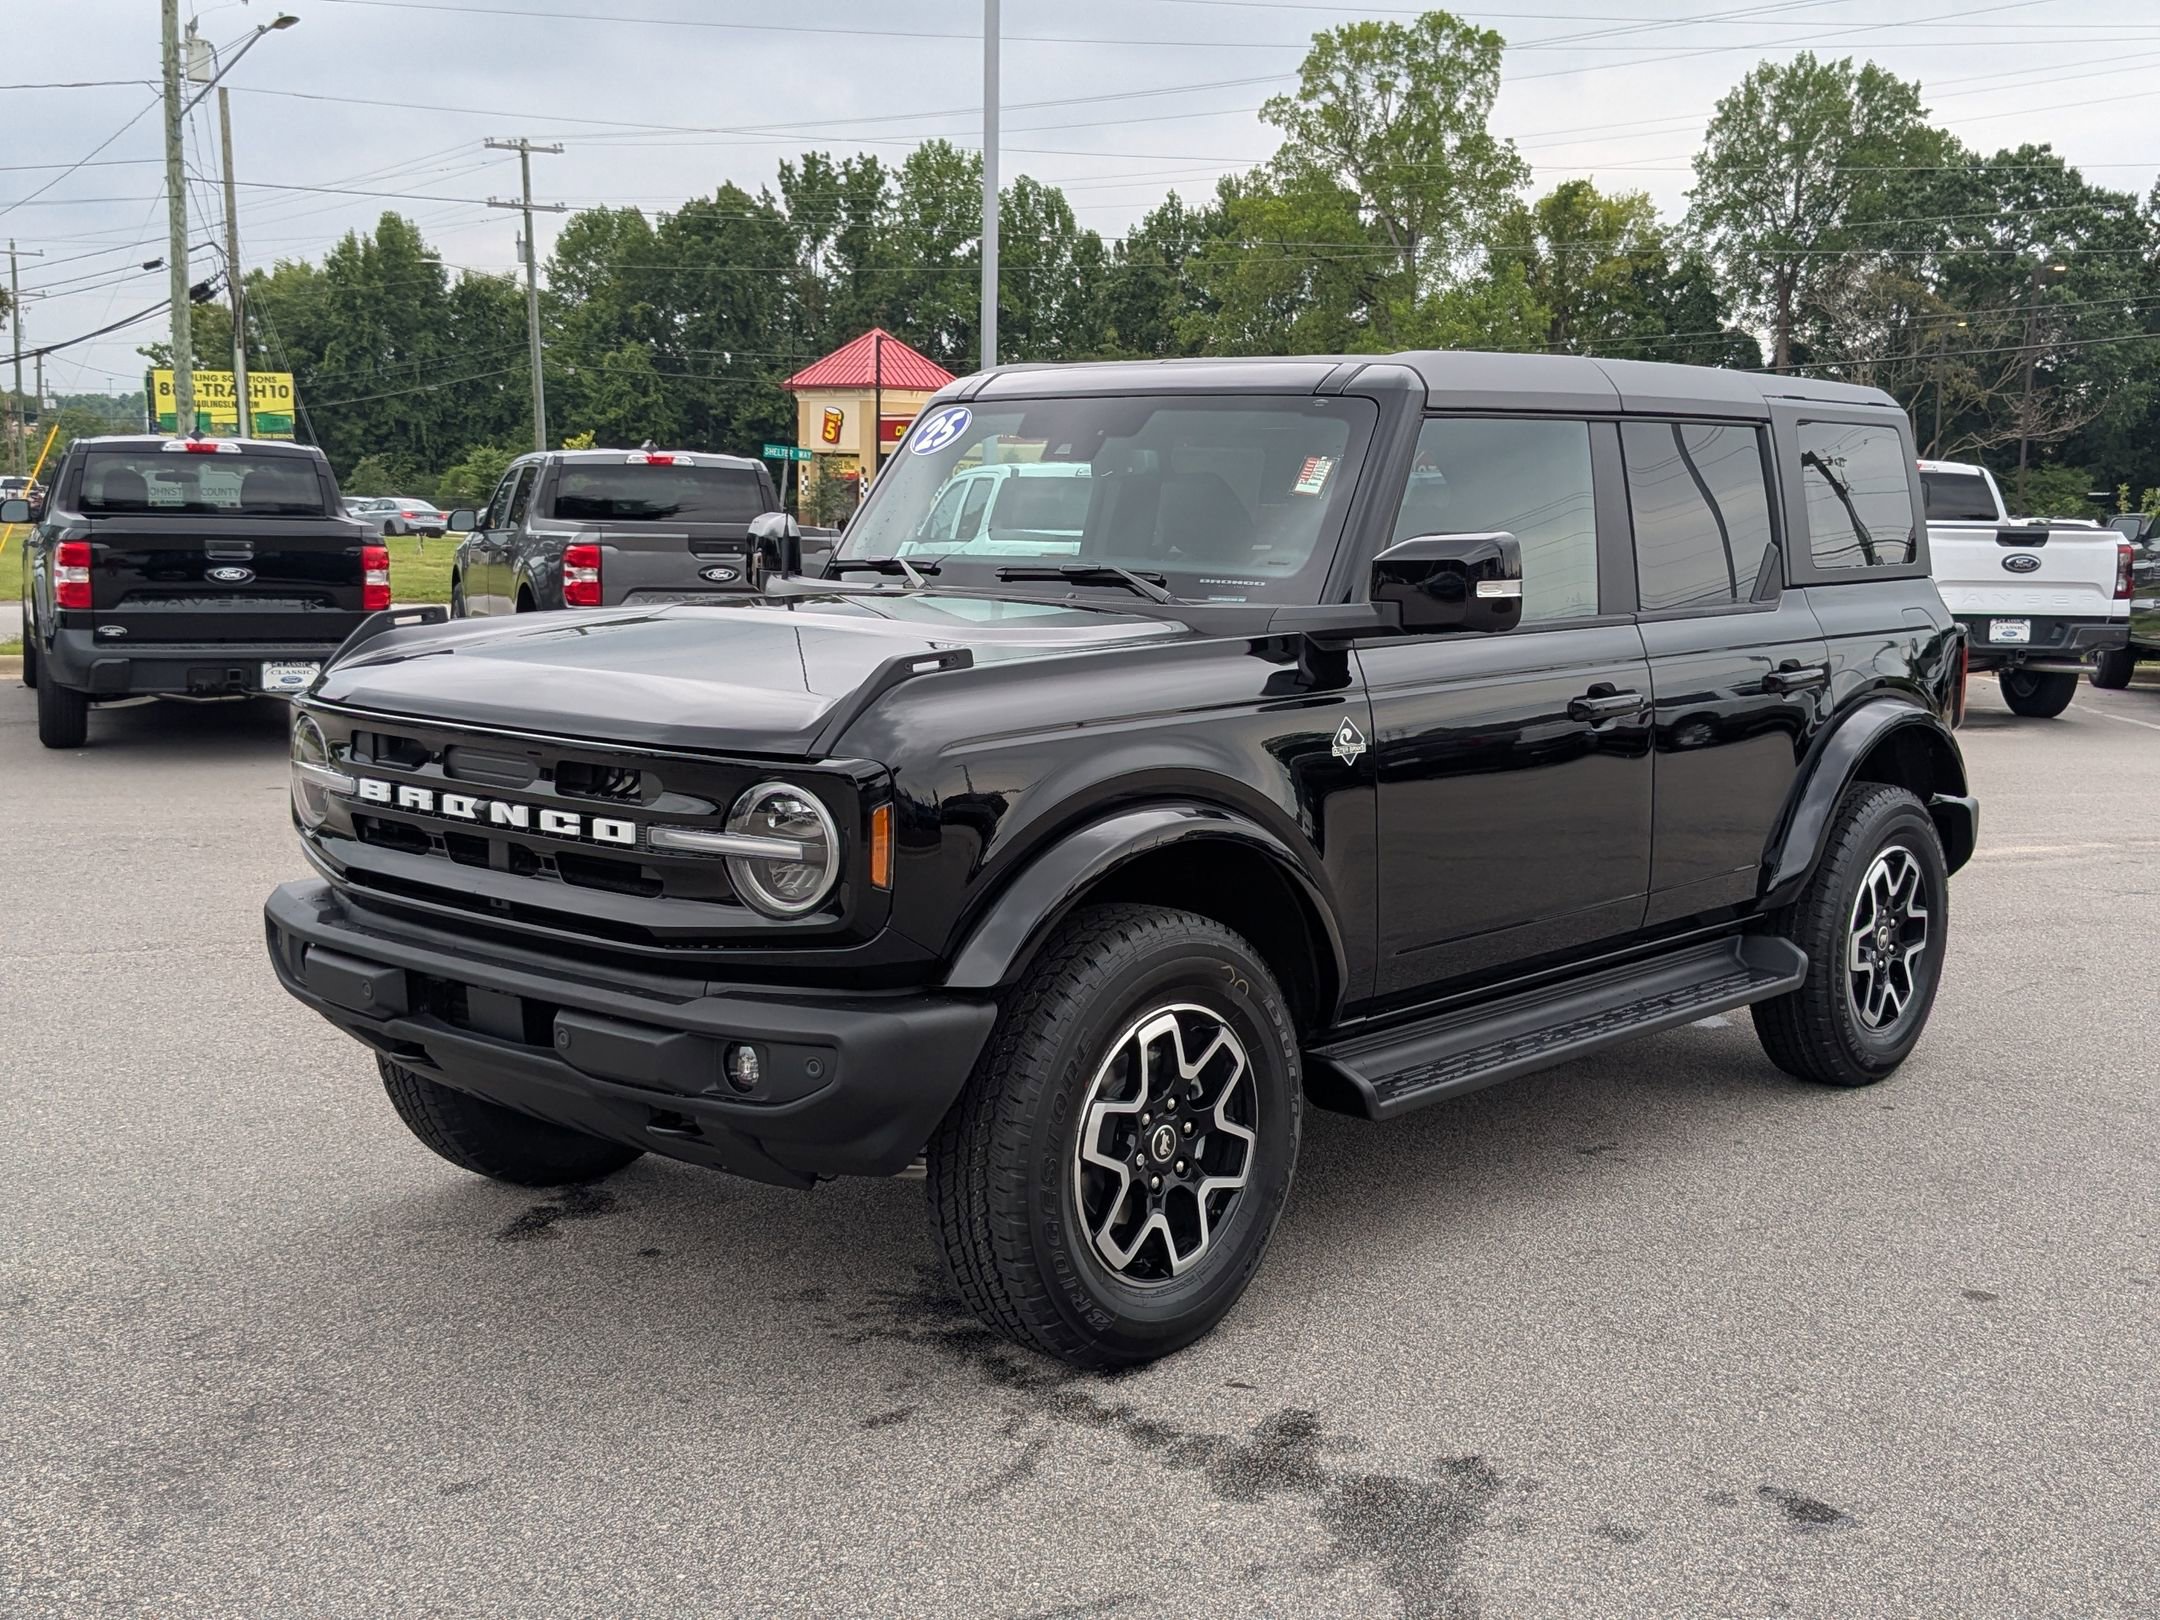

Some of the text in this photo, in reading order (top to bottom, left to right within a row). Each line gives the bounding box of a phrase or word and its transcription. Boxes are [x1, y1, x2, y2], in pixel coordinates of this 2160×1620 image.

[222, 374, 277, 383] SOTIONS
[159, 382, 289, 398] 8-TRASH10
[824, 421, 836, 440] 5
[914, 410, 966, 451] 25
[764, 447, 812, 460] SHELTER WAY
[201, 488, 240, 496] COUNTY
[359, 778, 636, 844] BRONCO
